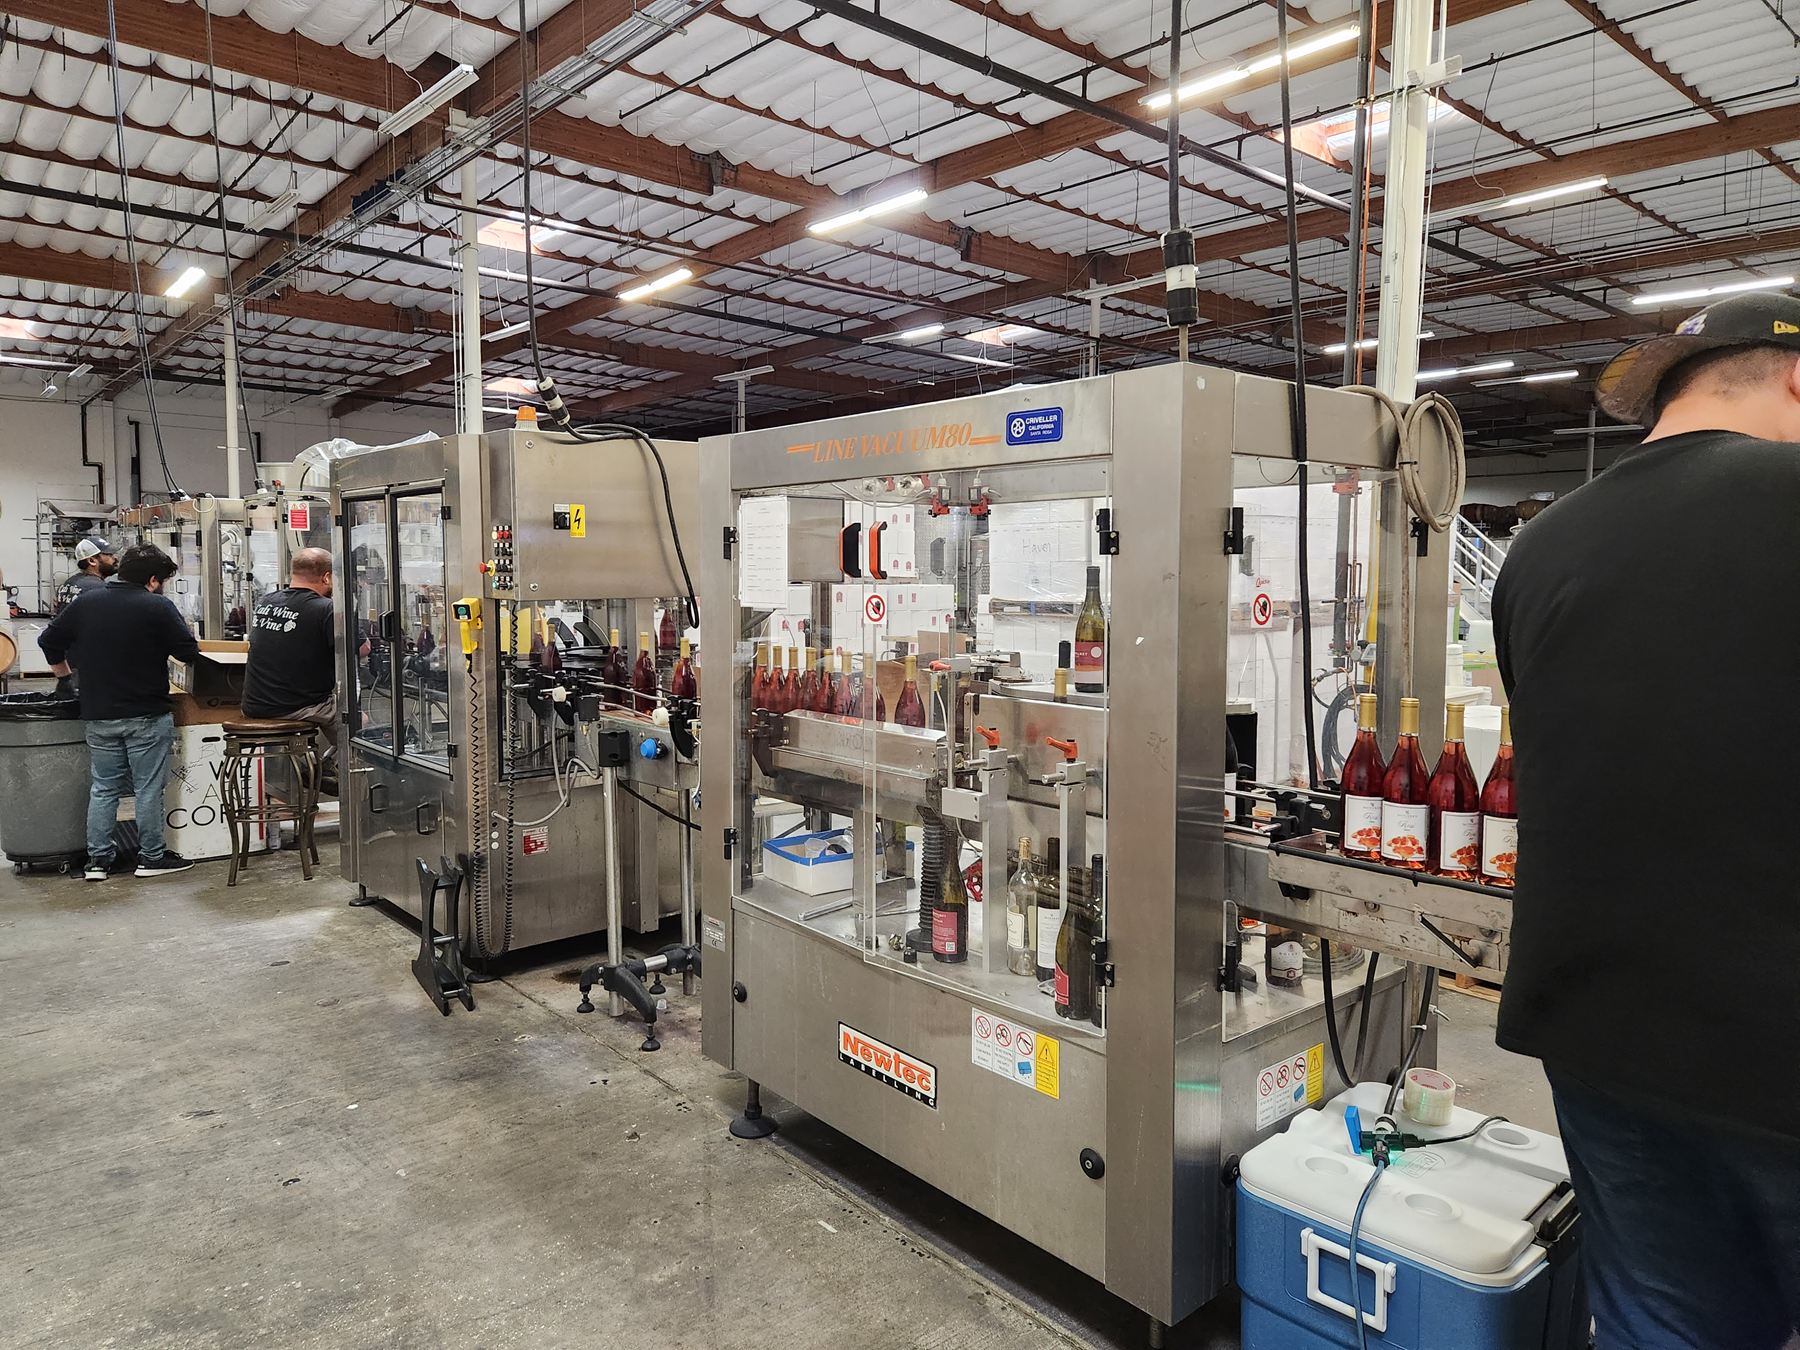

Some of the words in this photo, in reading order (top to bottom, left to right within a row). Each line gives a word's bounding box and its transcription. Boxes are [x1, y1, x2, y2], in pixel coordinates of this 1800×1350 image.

[1025, 414, 1058, 425] CRIVELLER
[1028, 423, 1055, 431] CALIFORNIA
[812, 436, 857, 463] LINE
[273, 606, 300, 620] Wine
[260, 617, 282, 631] Vine
[843, 1031, 931, 1091] Newtec
[839, 1052, 935, 1106] LABELLING
